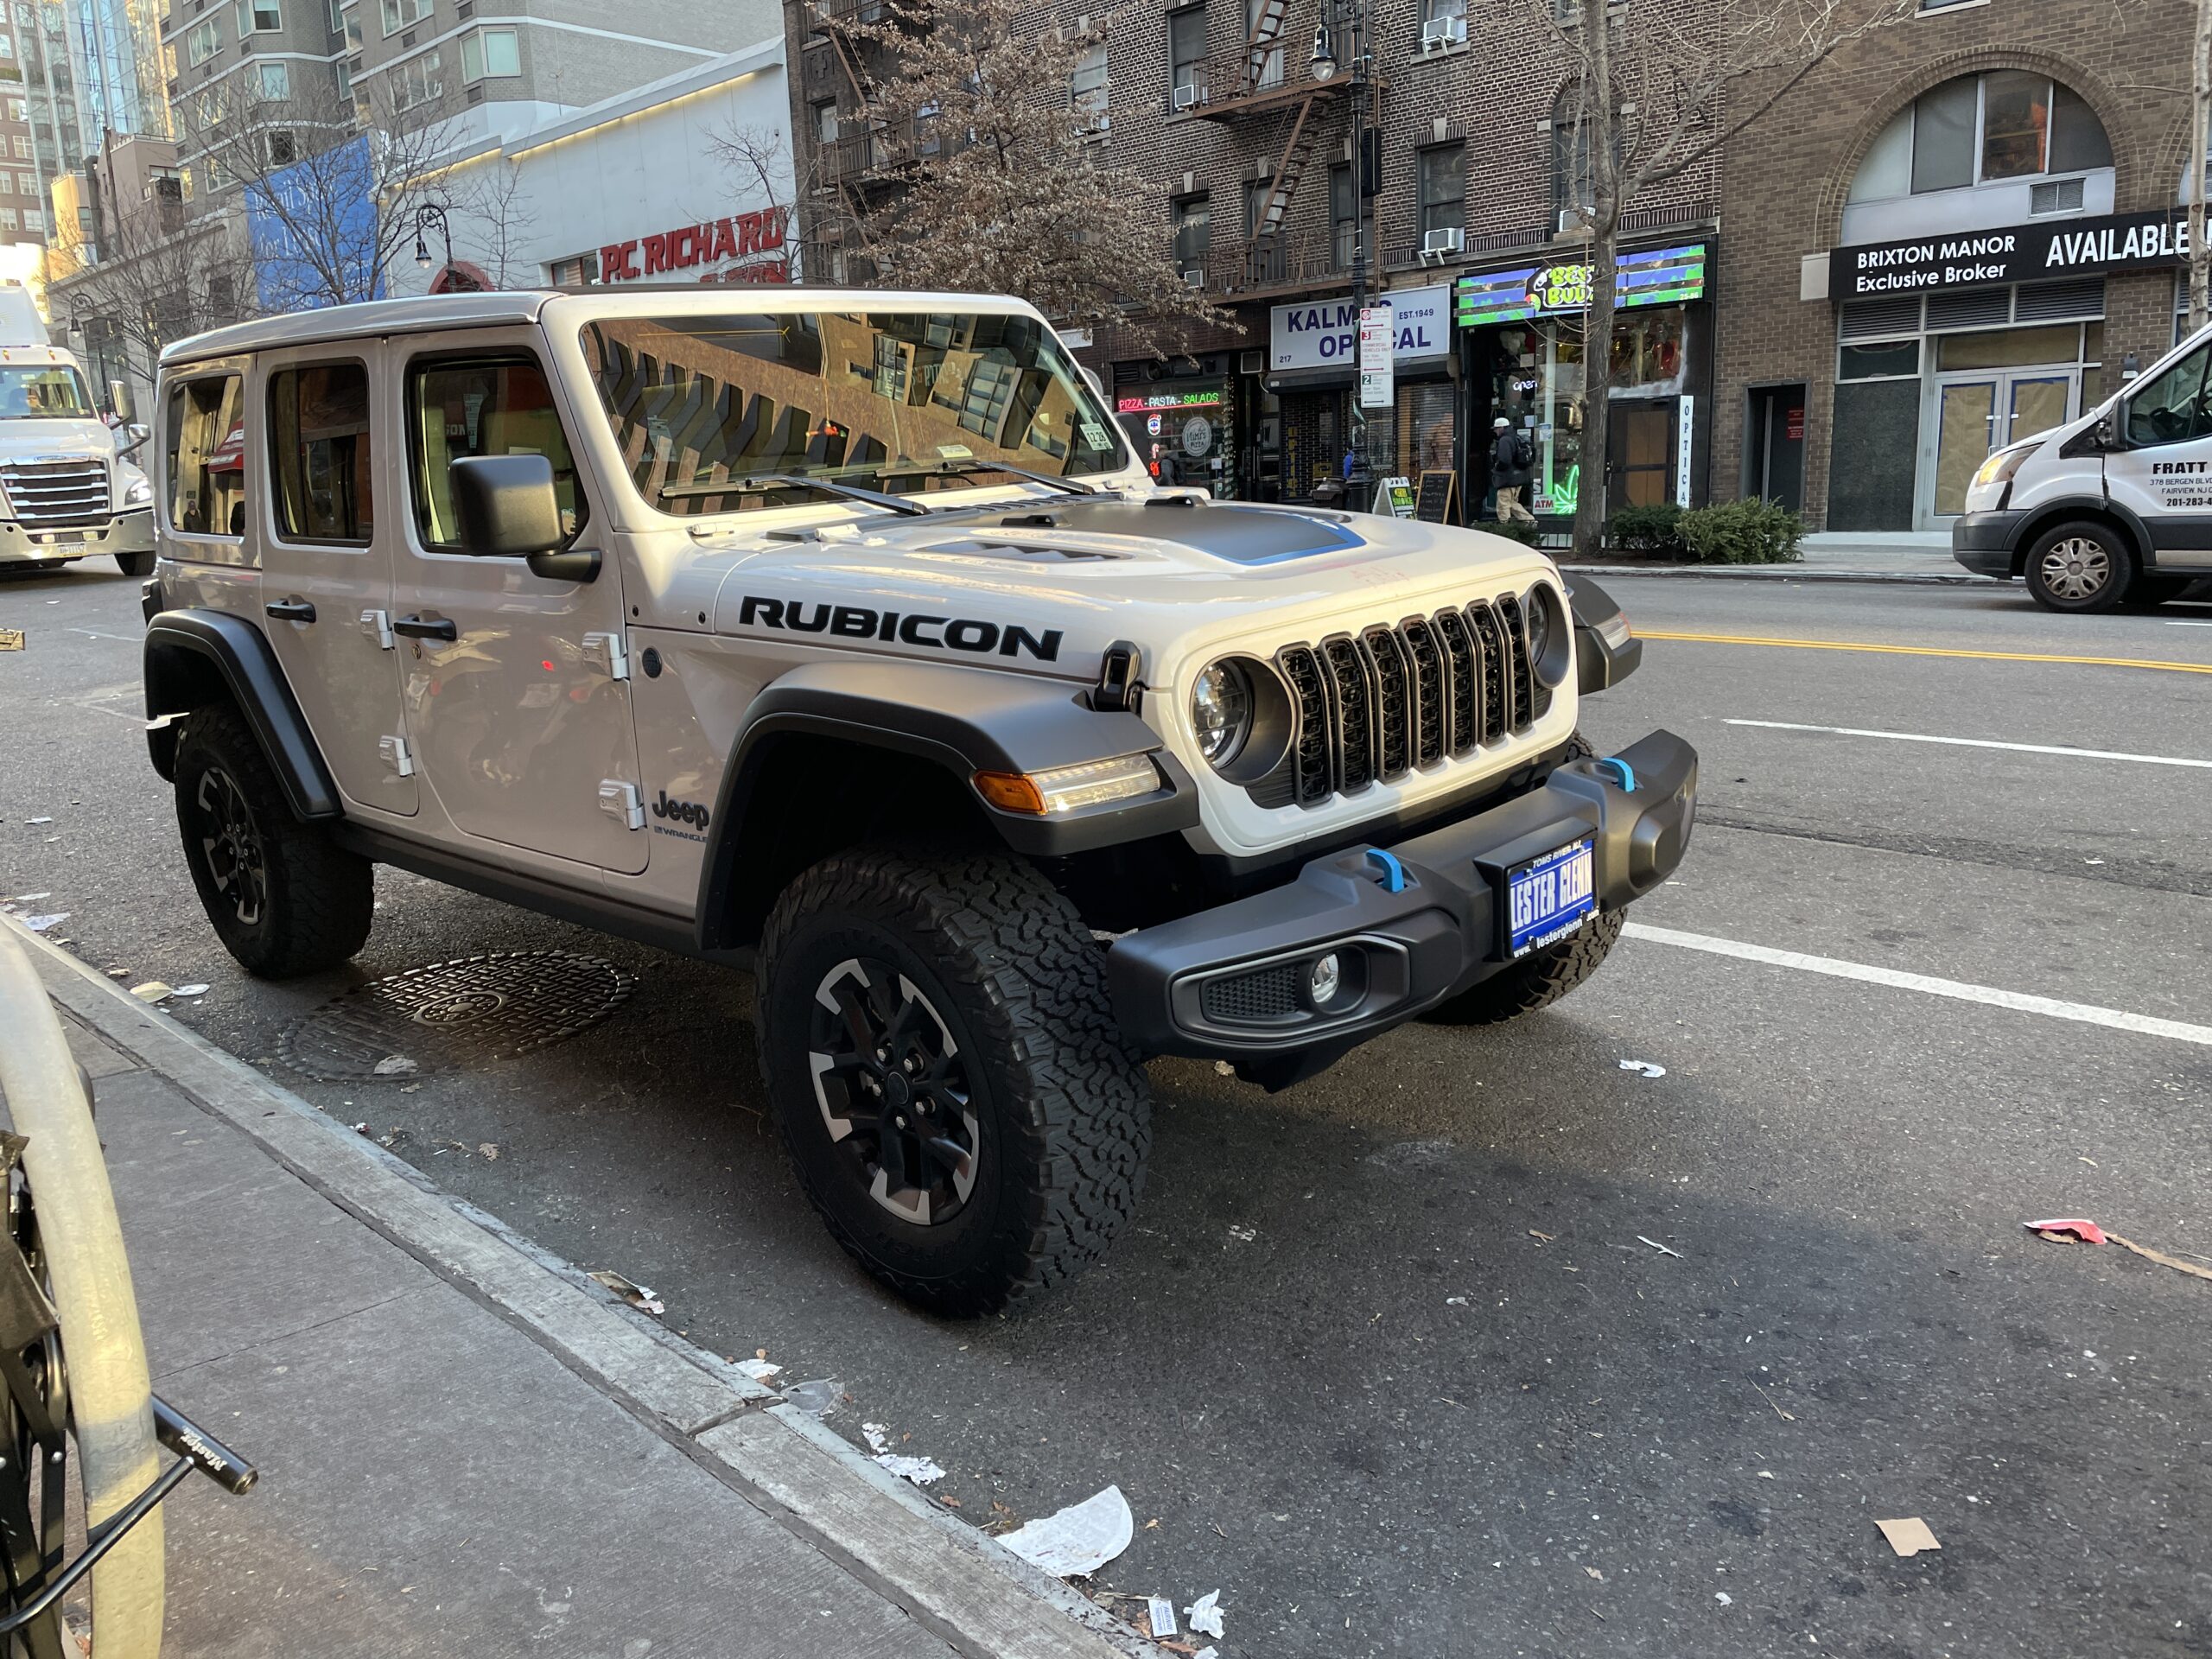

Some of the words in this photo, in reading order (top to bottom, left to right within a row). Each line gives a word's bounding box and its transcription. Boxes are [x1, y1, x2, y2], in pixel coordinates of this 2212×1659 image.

[601, 240, 640, 283] P.C.
[642, 207, 787, 275] RICHARD
[1857, 245, 1935, 270] BRIXTON
[1939, 235, 2016, 259] MANOR
[2045, 221, 2190, 268] AVAILABLE
[1855, 269, 1939, 293] Exclusive
[1944, 263, 2007, 283] Broker
[1399, 308, 1434, 320] EST.1949
[1280, 355, 1292, 364] 217
[1119, 398, 1143, 410] PIZZA
[1148, 396, 1176, 407] PASTA
[1184, 392, 1219, 404] SALADS
[1513, 380, 1538, 391] open
[1681, 405, 1690, 505] OPTICA
[2152, 461, 2208, 474] FRATT
[1535, 499, 1554, 508] ATM
[739, 595, 1065, 662] RUBICON
[652, 790, 709, 831] Jeep
[1532, 854, 1553, 869] TOMS
[1573, 840, 1582, 853] NJ
[1510, 870, 1555, 931] LESTER
[1560, 851, 1592, 908] GLENN
[180, 1434, 228, 1471] Master
